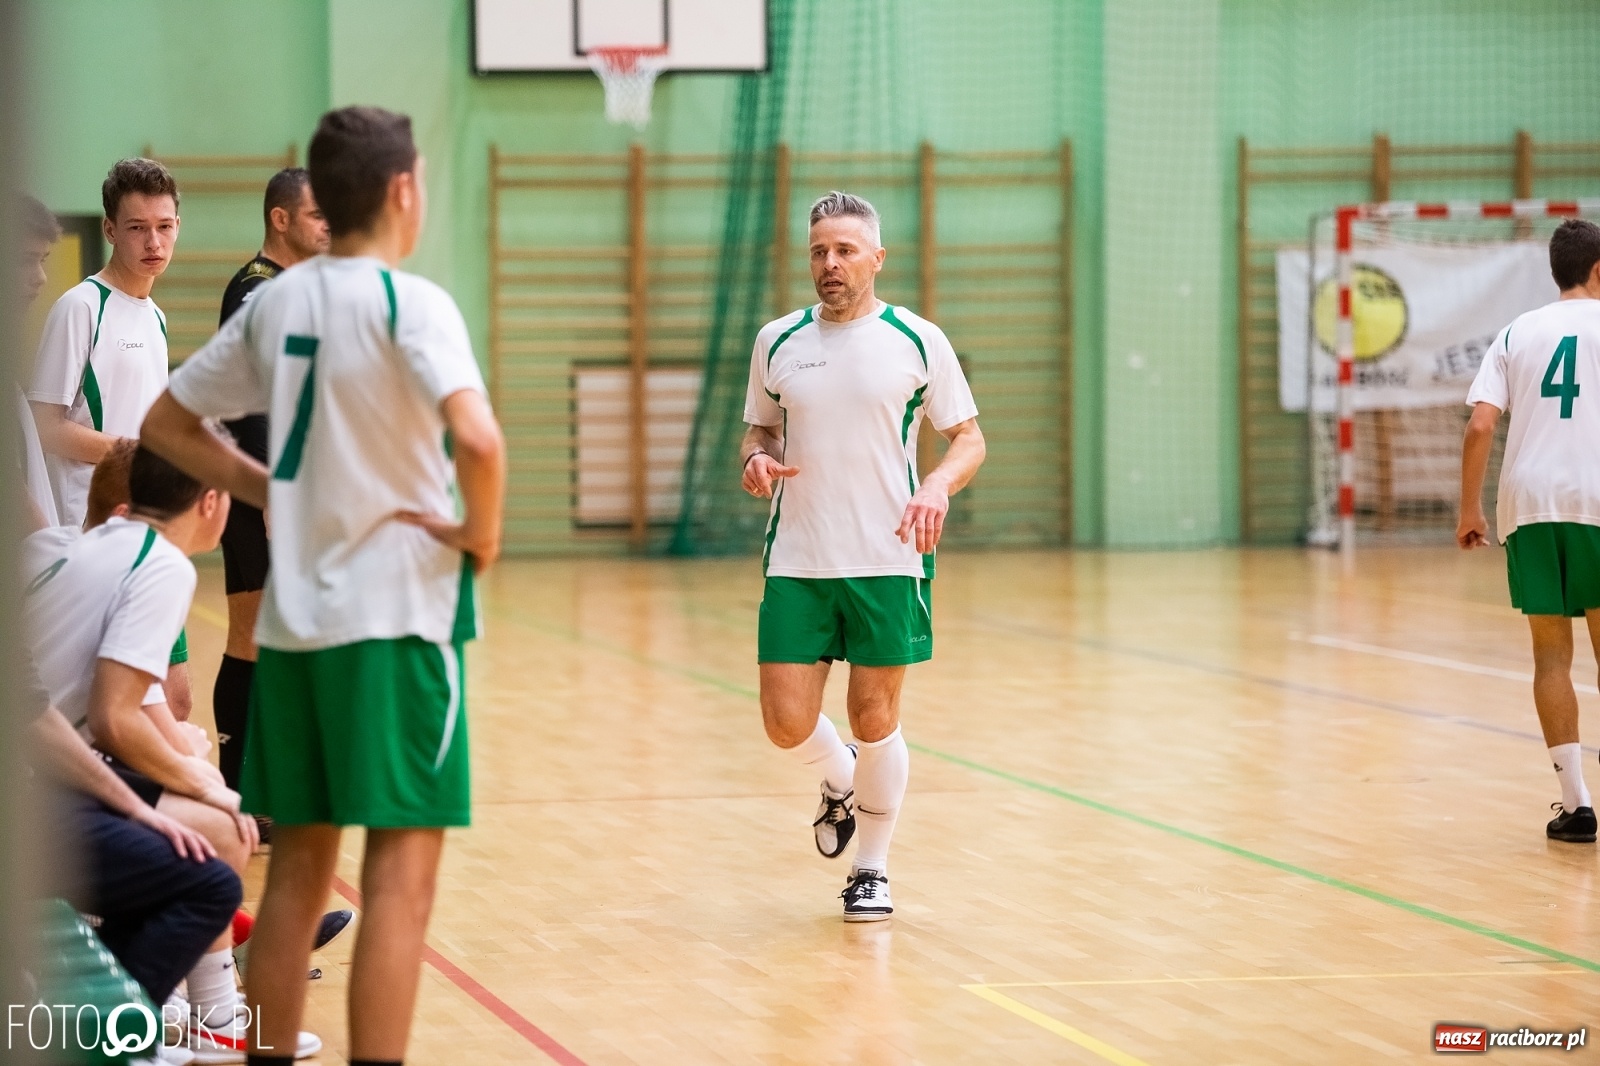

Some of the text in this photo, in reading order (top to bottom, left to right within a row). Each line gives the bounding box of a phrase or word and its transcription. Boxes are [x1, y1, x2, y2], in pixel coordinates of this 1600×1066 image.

[799, 361, 827, 369] COLO
[1540, 335, 1580, 419] 4
[273, 334, 320, 482] 7
